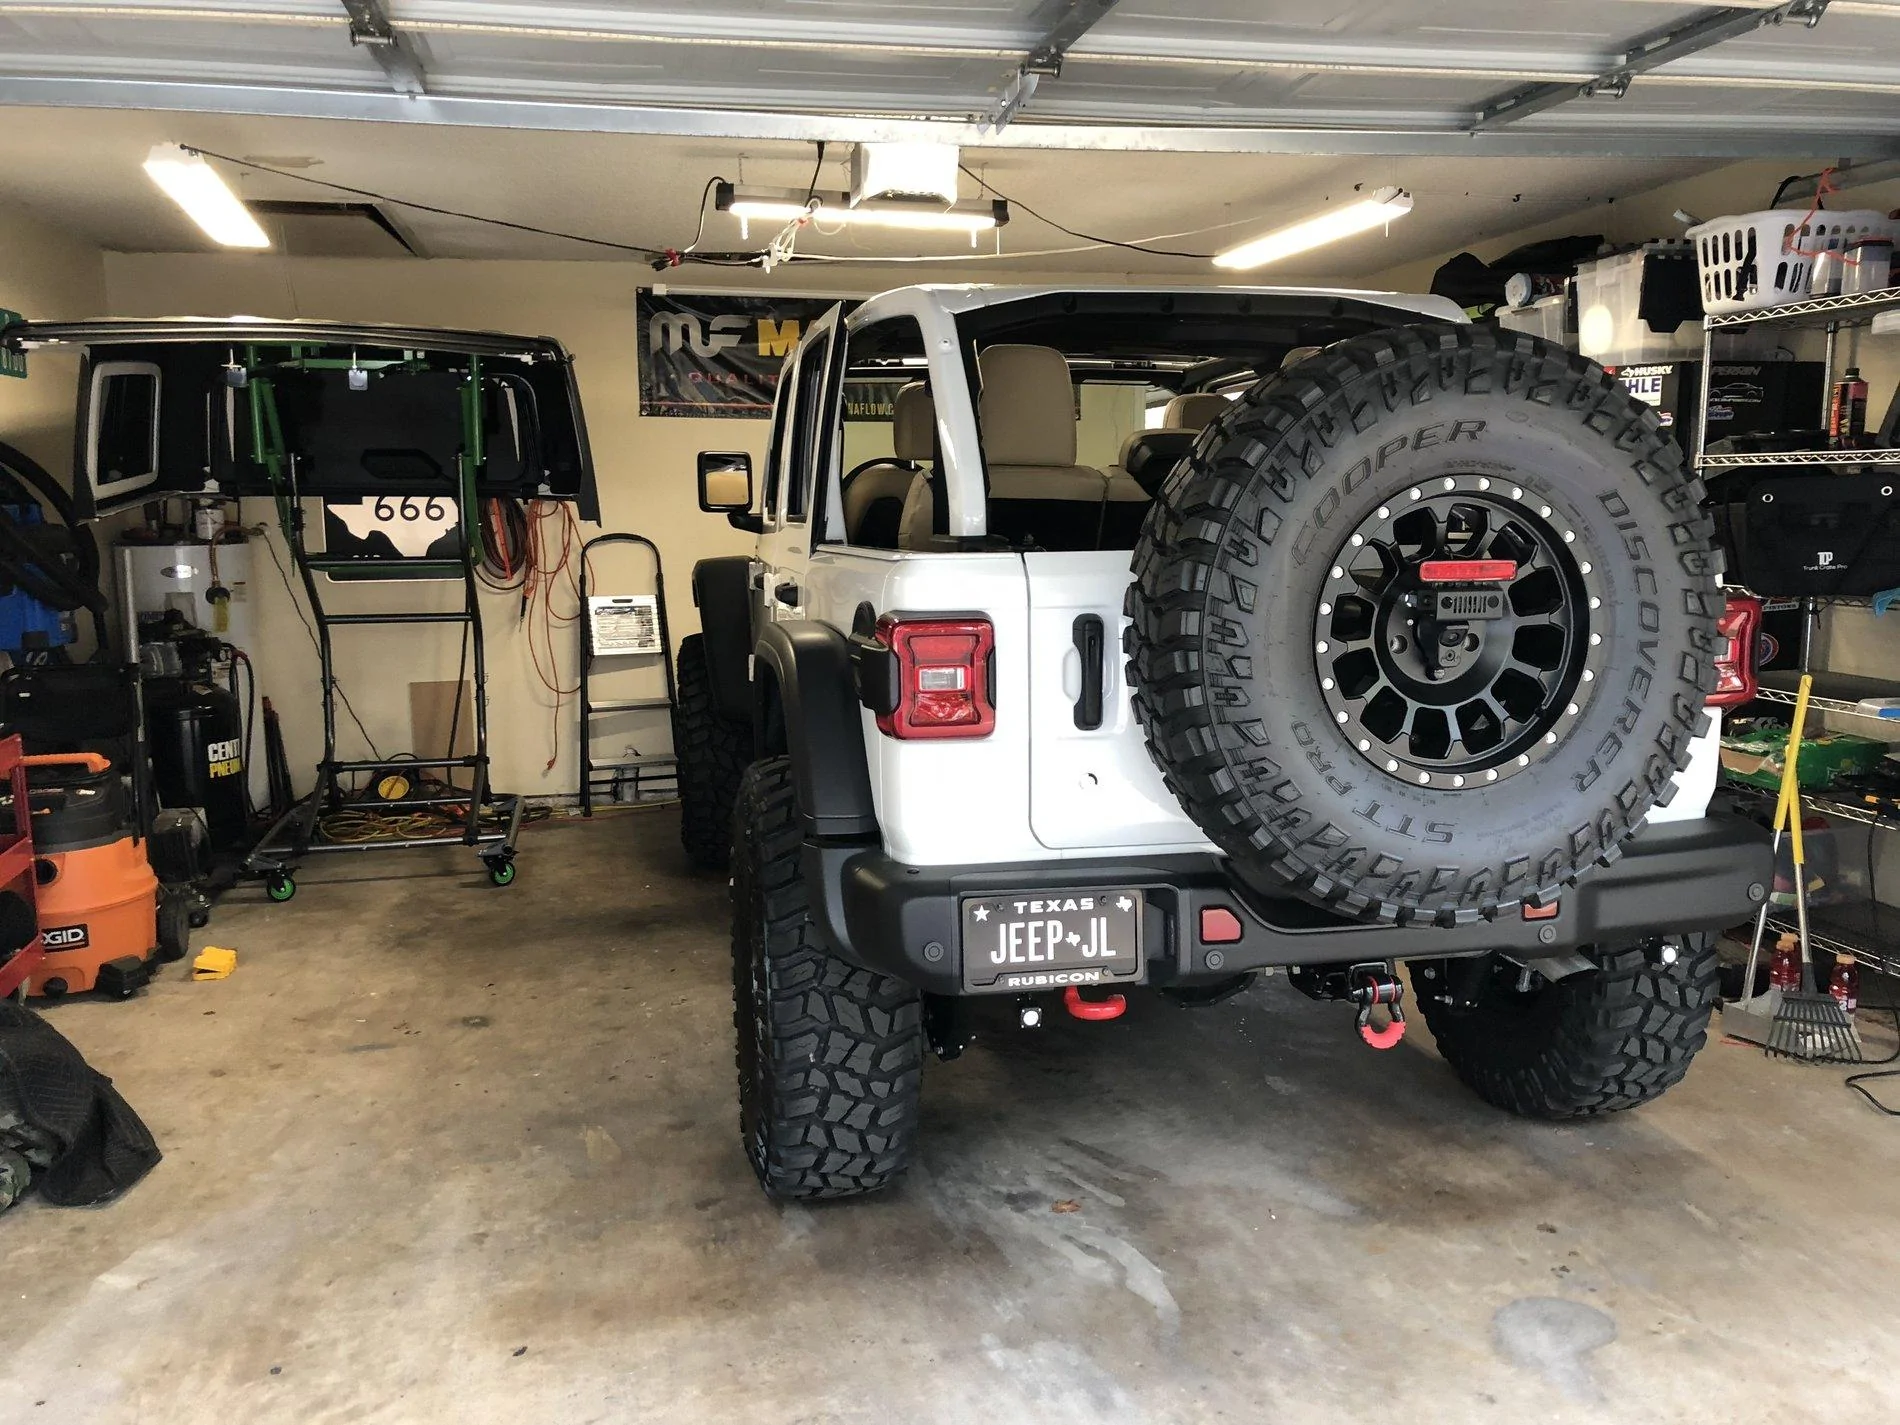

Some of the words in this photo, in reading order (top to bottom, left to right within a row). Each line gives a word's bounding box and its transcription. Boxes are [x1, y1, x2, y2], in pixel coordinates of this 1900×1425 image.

[1634, 365, 1673, 376] HUSKY
[1291, 419, 1487, 567] COOPER
[1570, 488, 1660, 793] DISCOVERER
[1013, 897, 1095, 915] TEXAS
[990, 919, 1064, 965] JEEP
[1008, 971, 1100, 987] RUBICON
